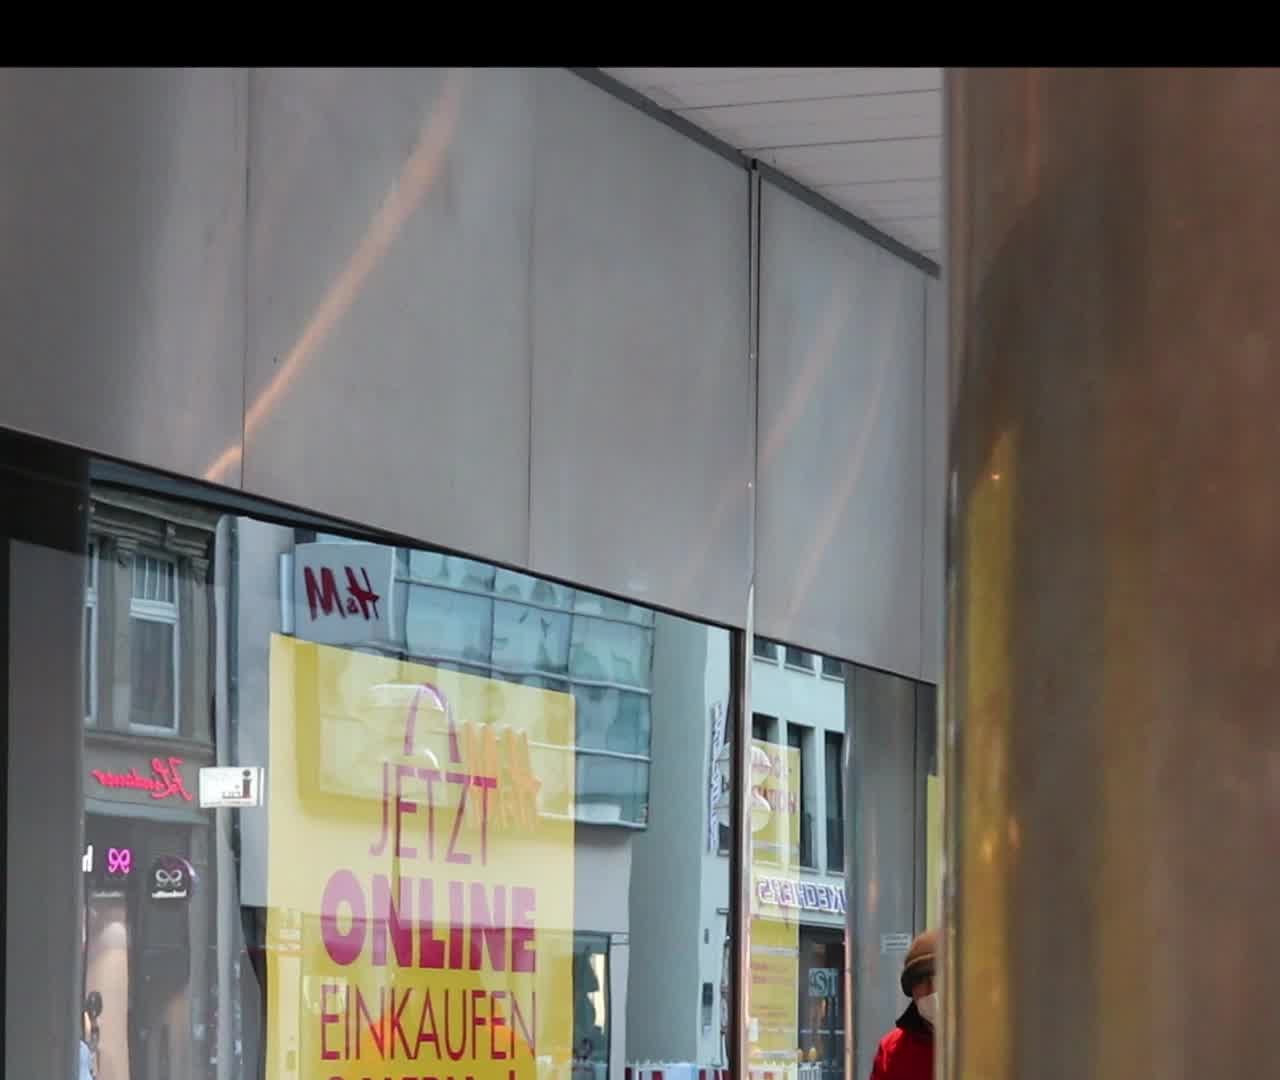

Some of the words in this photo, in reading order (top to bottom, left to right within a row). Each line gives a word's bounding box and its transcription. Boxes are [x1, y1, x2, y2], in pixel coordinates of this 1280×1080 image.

[369, 761, 498, 864] JETZT
[321, 868, 538, 974] ONLINE
[320, 986, 537, 1062] EINKAUFEN
